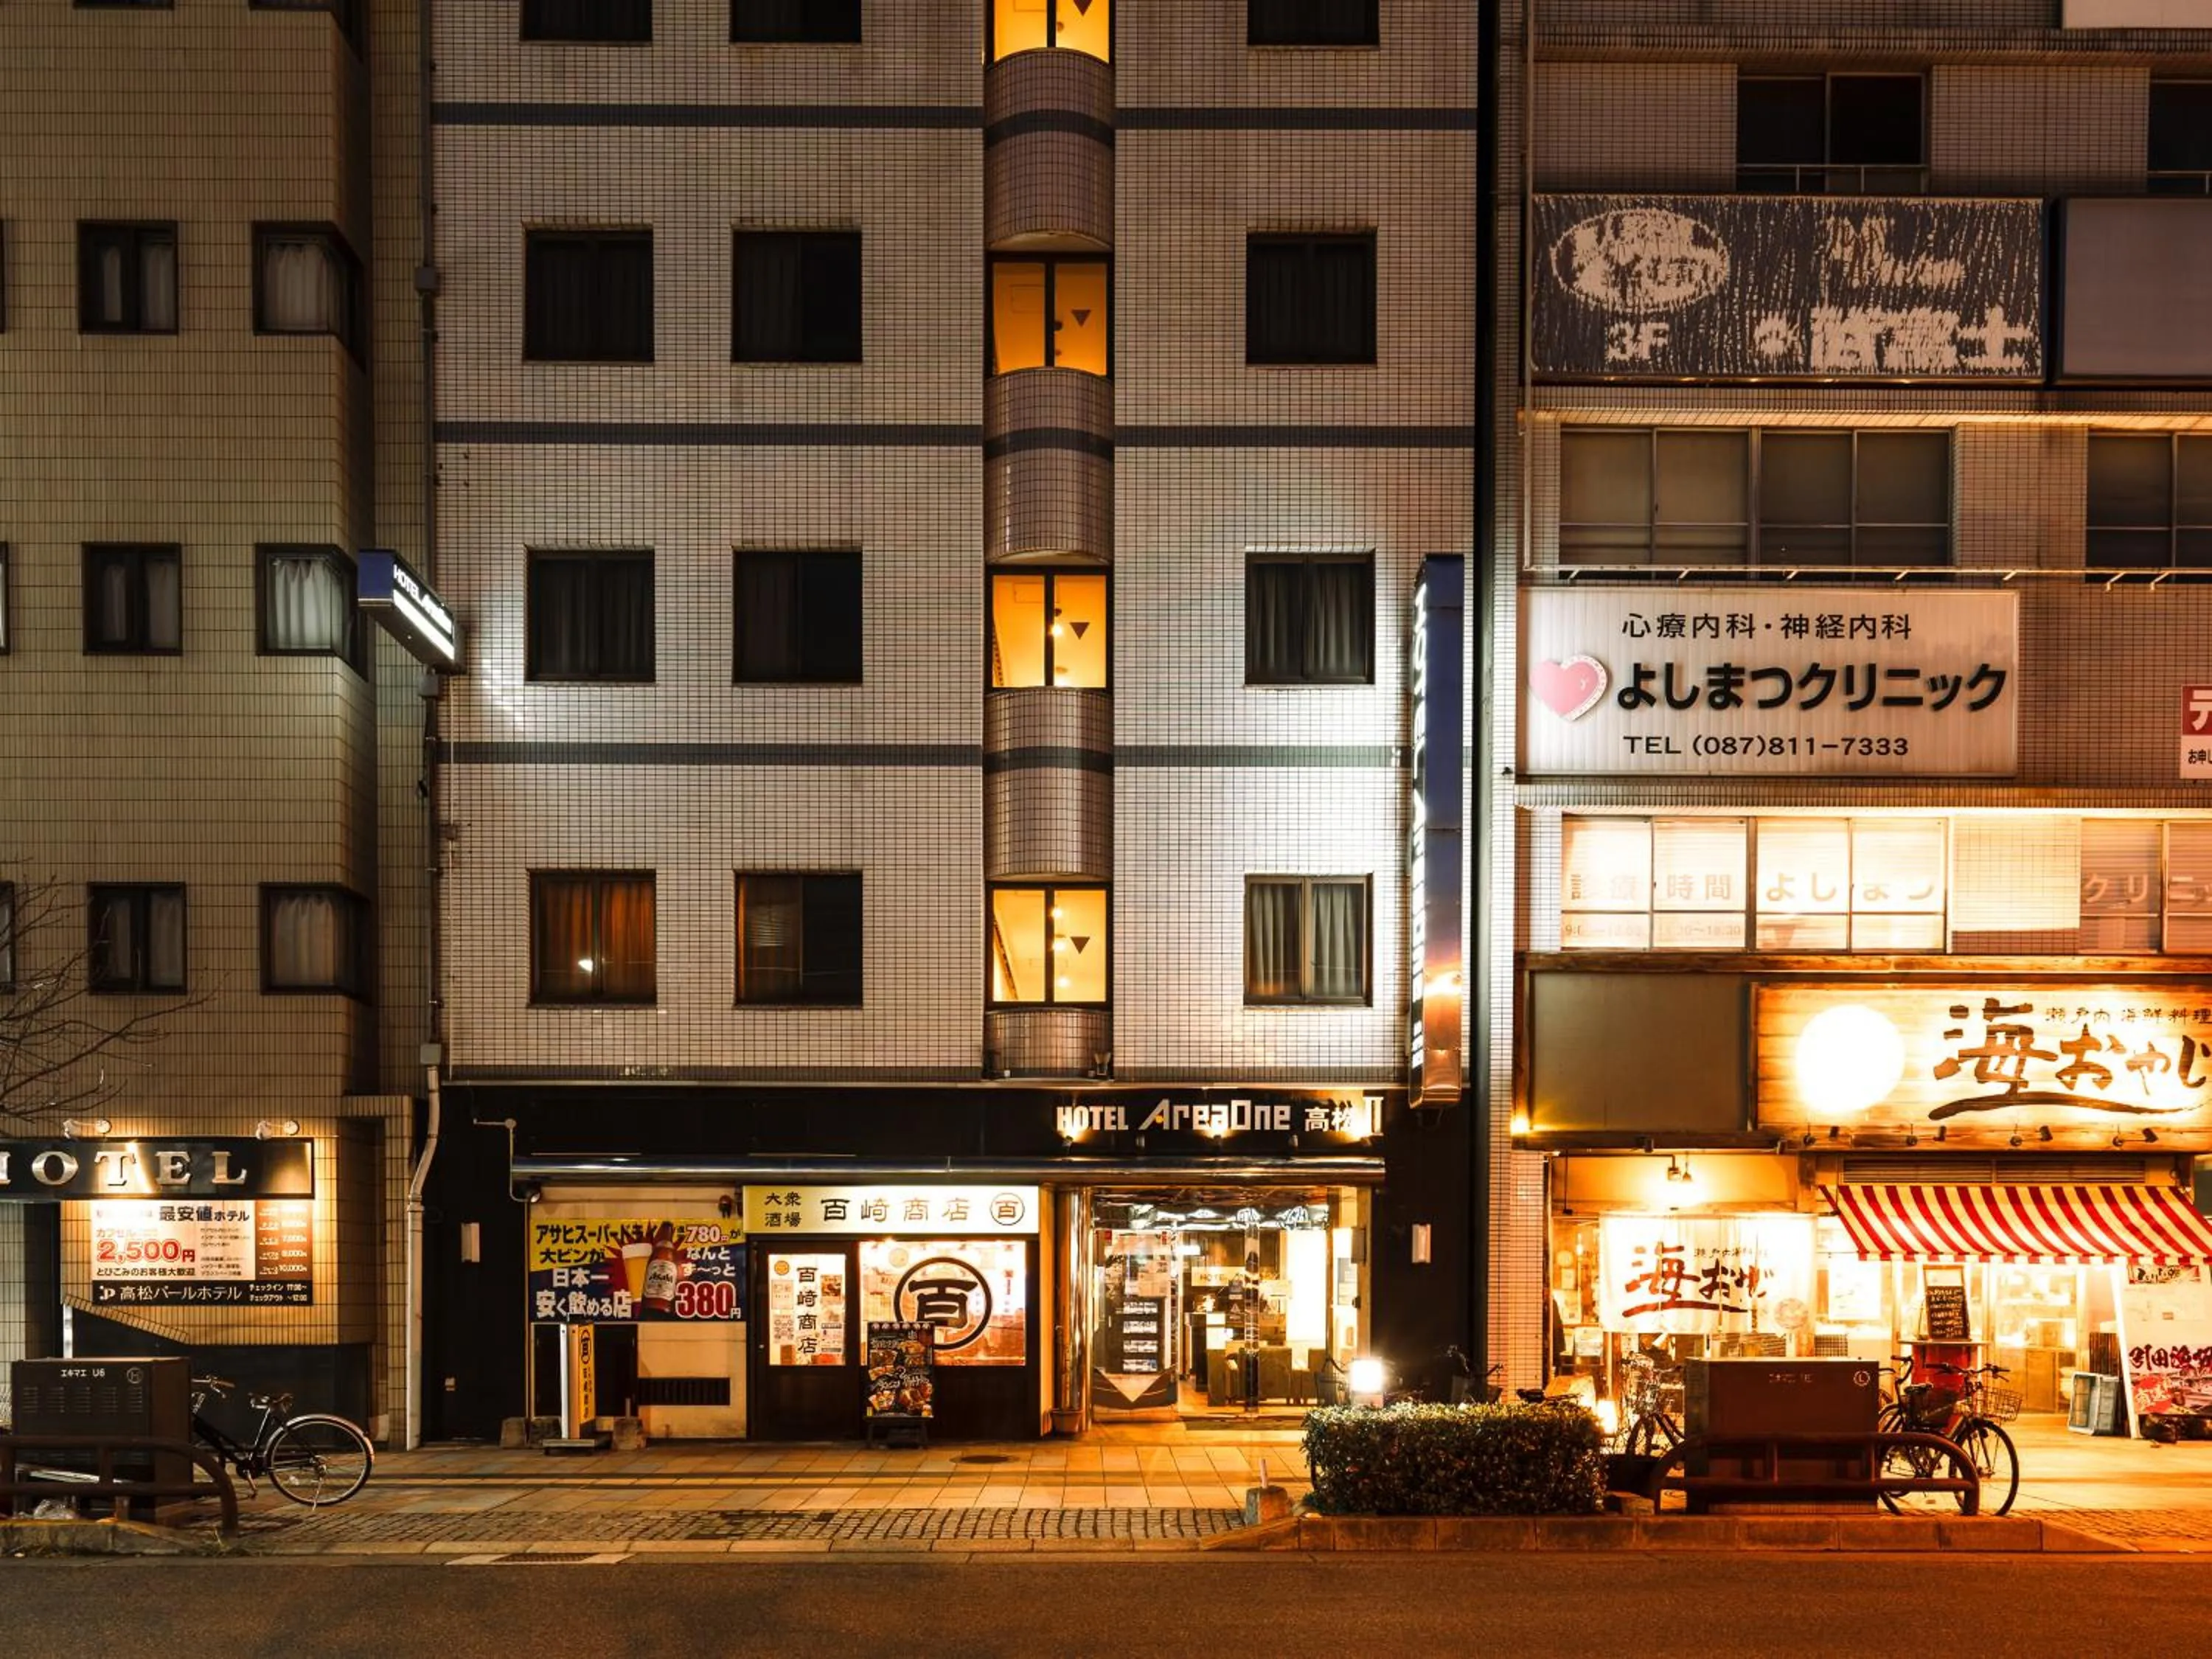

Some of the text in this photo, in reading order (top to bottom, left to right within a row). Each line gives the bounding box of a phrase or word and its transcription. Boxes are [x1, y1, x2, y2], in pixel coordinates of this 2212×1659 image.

[1621, 613, 1912, 640] 心療内科・神経内科
[1617, 662, 2007, 712] よしまつクリニック
[1623, 736, 1682, 755] TEL
[1057, 1106, 1129, 1130] HOTEL
[1138, 1098, 1292, 1130] AreaOne
[159, 1206, 250, 1222] 最安値ホテル
[97, 1238, 195, 1264] 2,500円
[540, 1247, 606, 1264] 大ビンが
[686, 1246, 731, 1260] なんと
[553, 1267, 610, 1287] 日本一
[120, 1285, 243, 1301] 高松パールホテル
[536, 1289, 632, 1318] 安く飲める店
